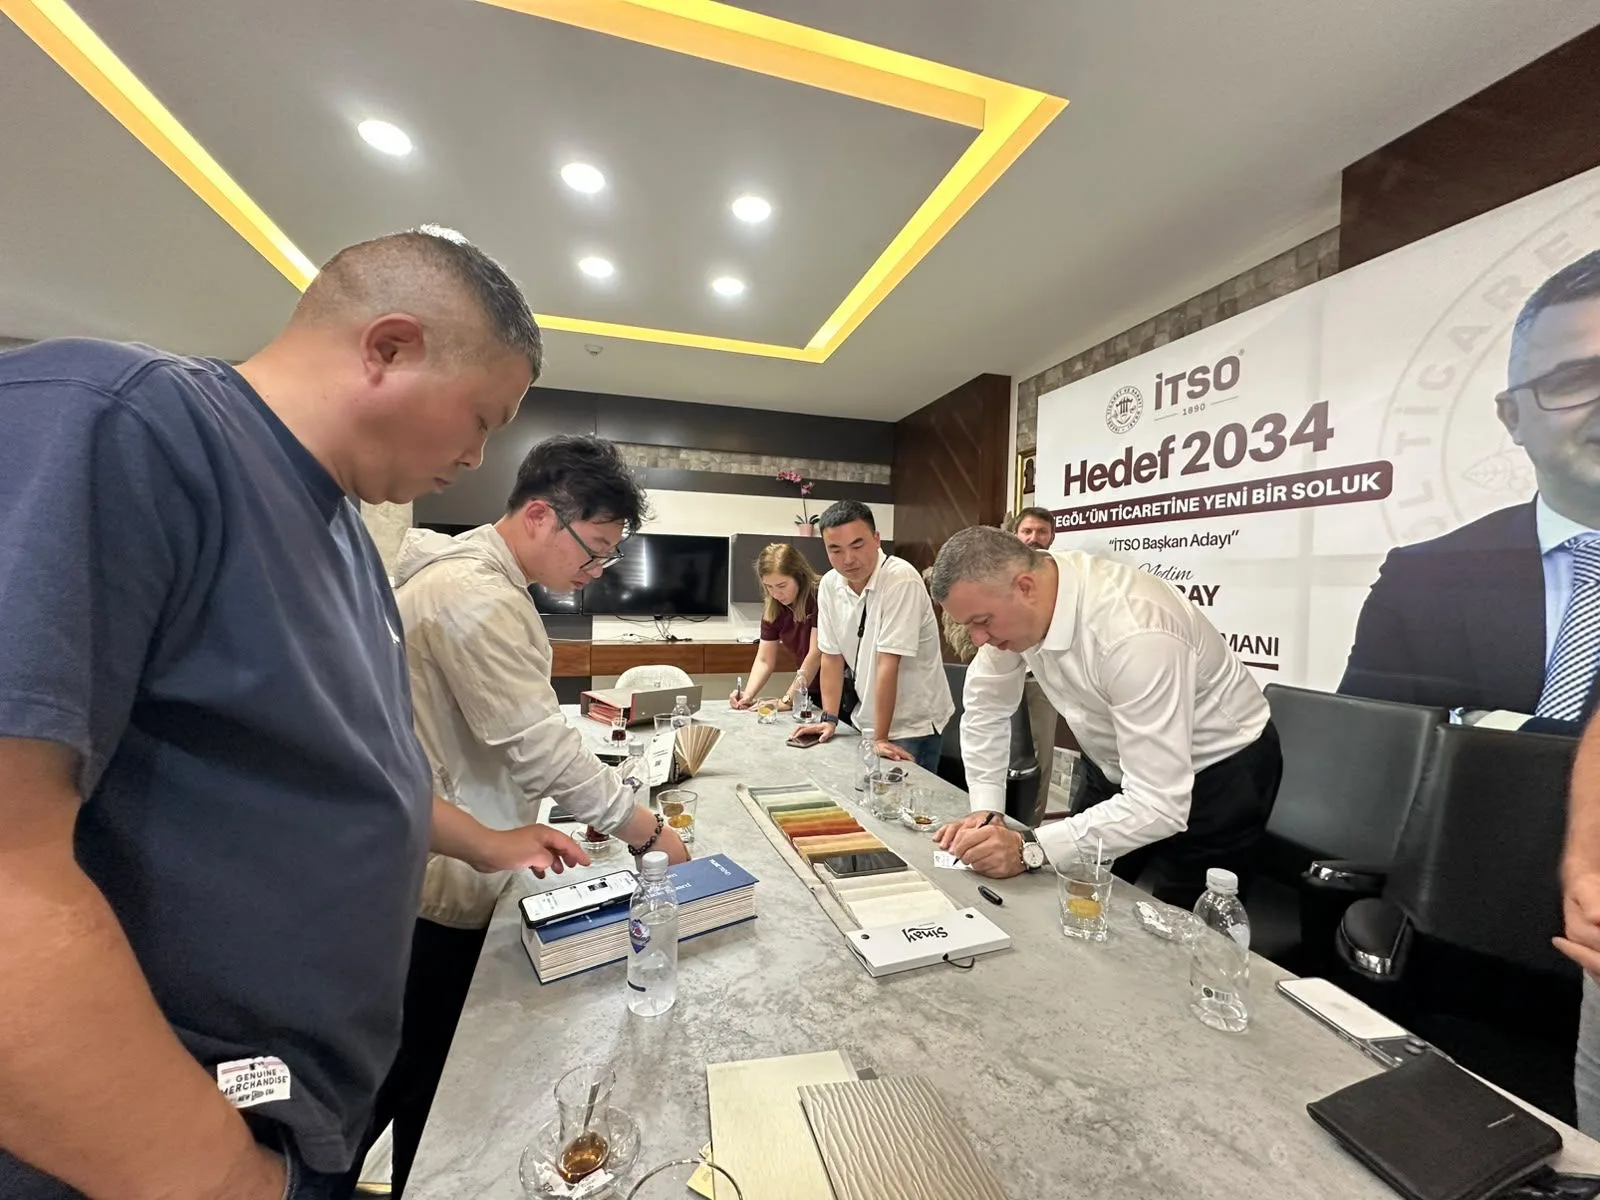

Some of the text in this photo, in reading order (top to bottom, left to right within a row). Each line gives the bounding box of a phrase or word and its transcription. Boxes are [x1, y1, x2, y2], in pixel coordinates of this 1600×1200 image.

[1155, 355, 1240, 411] İTSO
[1182, 403, 1206, 416] 1890
[1063, 435, 1176, 497] Hedef
[1180, 400, 1334, 476] 2034
[1053, 471, 1382, 528] EGÖL'ÜN TİCARETİNE YENİ BİR SOLUK
[1143, 535, 1188, 553] Başkan
[235, 1068, 277, 1083] GENUINE
